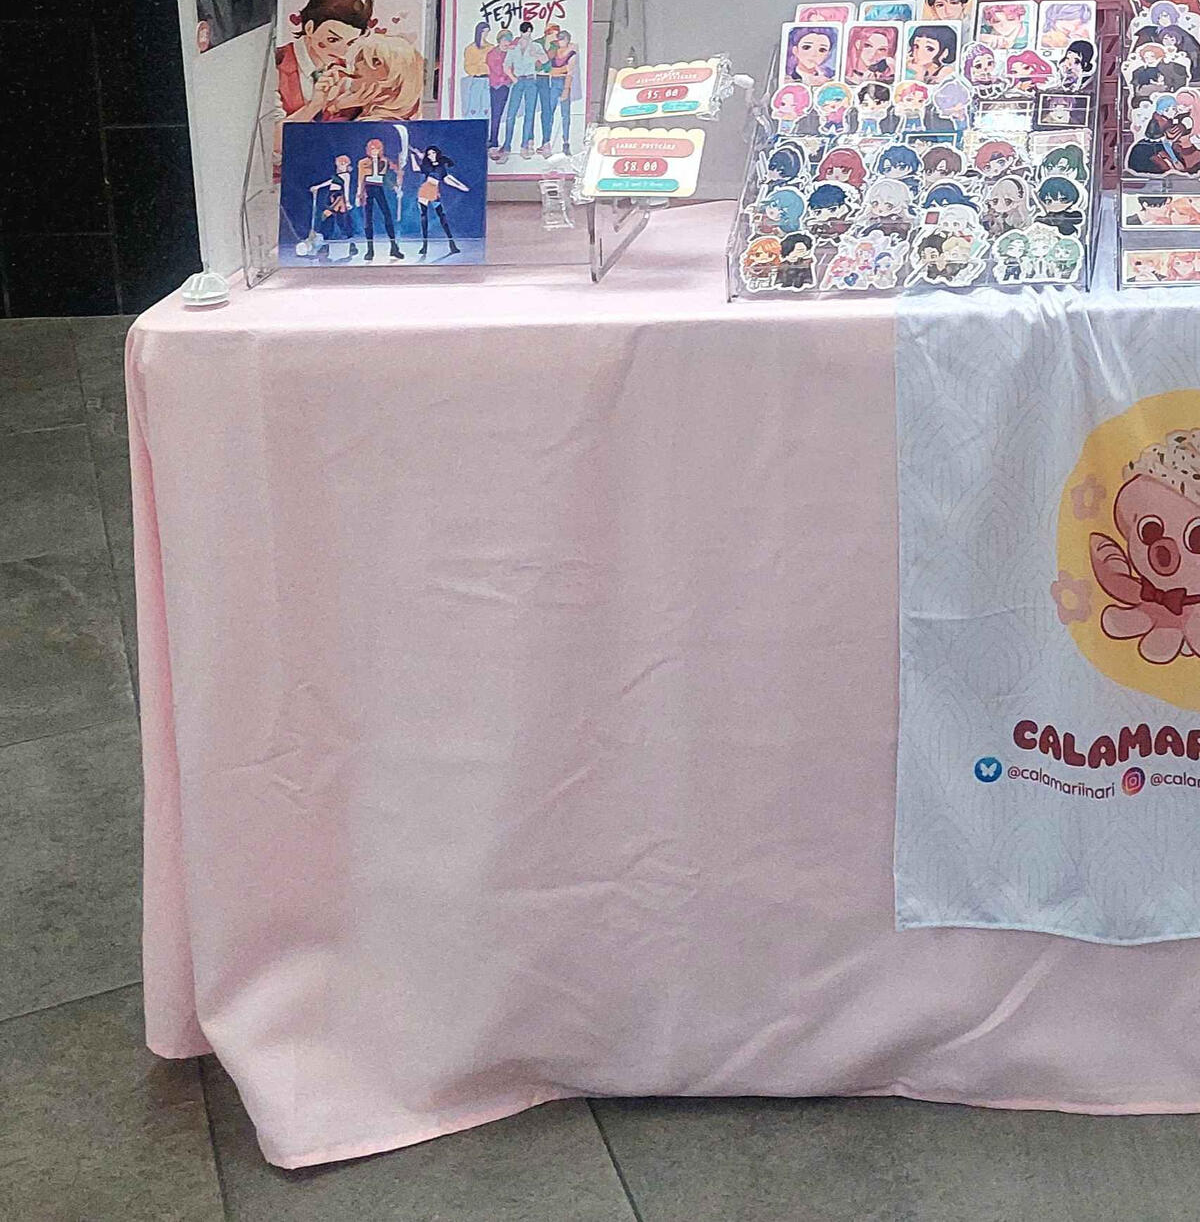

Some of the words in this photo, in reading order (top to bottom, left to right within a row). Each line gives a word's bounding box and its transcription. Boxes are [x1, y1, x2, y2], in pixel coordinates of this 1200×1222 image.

[646, 88, 679, 99] $5.00
[623, 161, 658, 172] $8.00
[1007, 766, 1115, 799] @calamariinari
